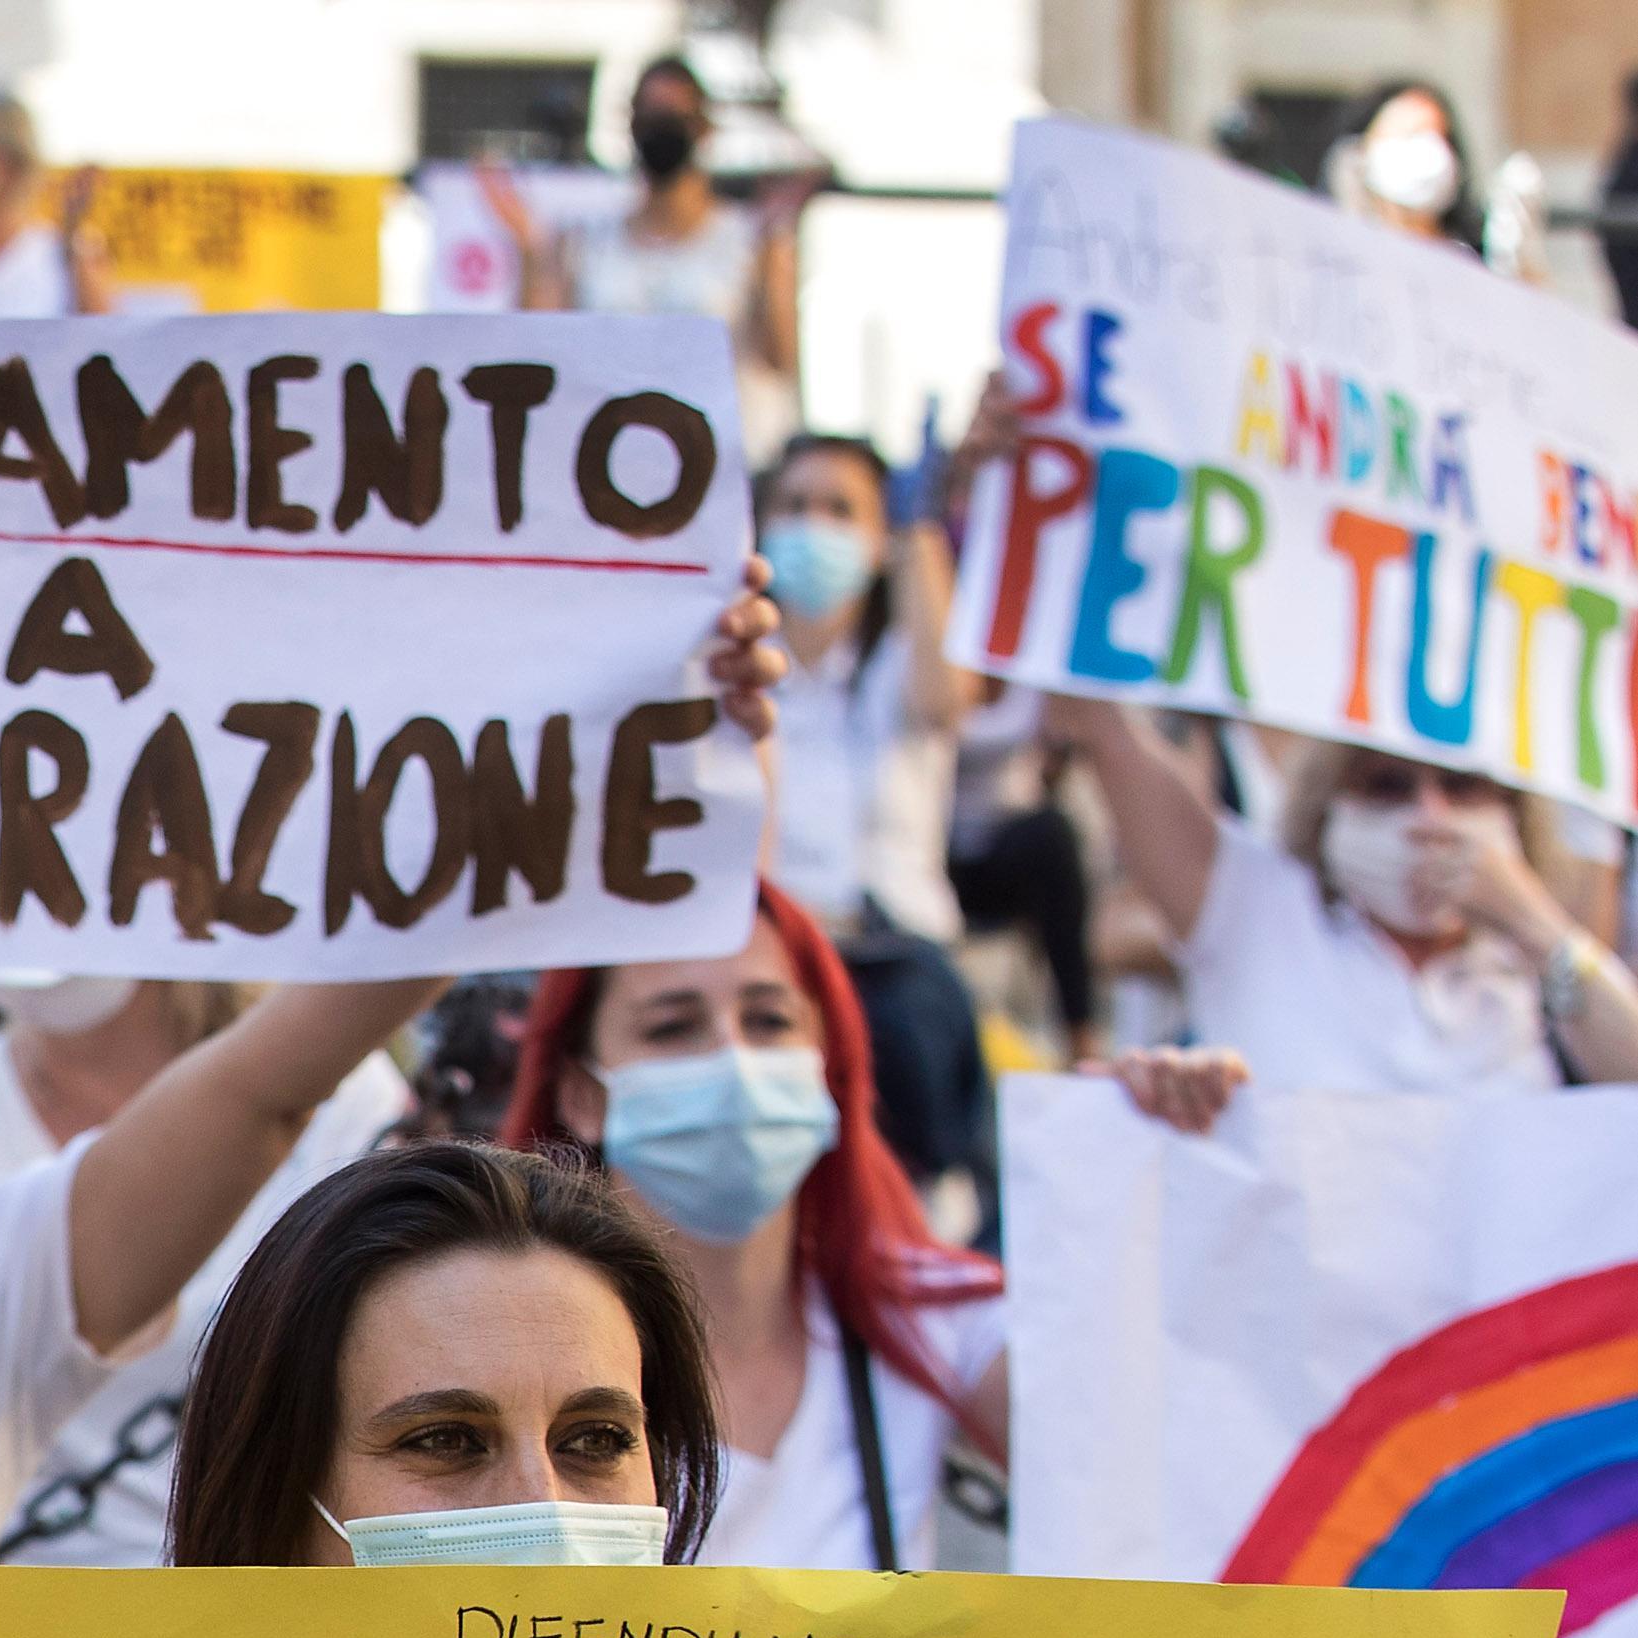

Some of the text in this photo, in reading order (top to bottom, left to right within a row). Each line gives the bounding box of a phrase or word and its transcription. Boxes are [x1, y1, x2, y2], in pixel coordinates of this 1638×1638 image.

[987, 432, 1267, 700] PER
[1009, 302, 1125, 428] SE
[1536, 448, 1638, 582] BEN
